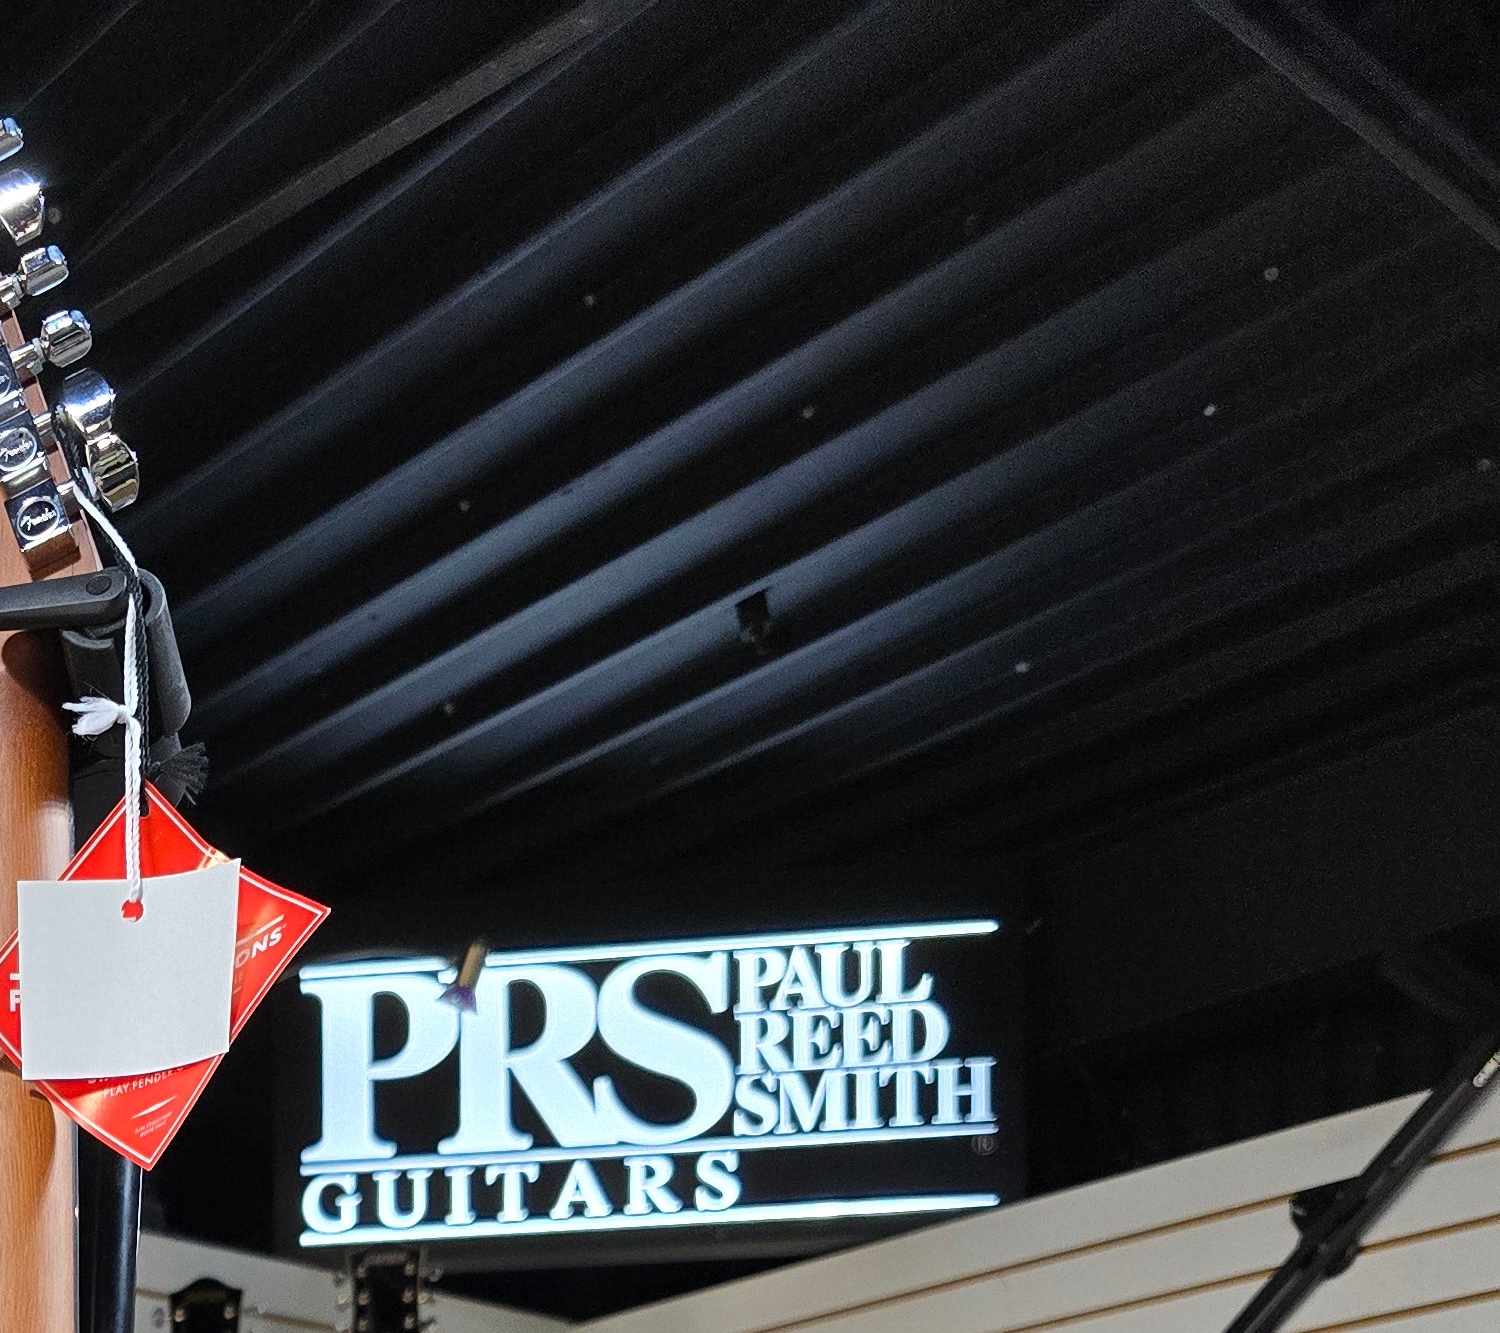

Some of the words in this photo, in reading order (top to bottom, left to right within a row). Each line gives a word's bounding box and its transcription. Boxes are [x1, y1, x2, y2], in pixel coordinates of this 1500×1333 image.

[20, 507, 57, 532] Fender
[733, 938, 932, 1013] PAUL
[300, 951, 736, 1166] PRS
[736, 1001, 950, 1076] REED
[733, 1056, 998, 1137] SMITH
[301, 1151, 742, 1234] GUITARS
